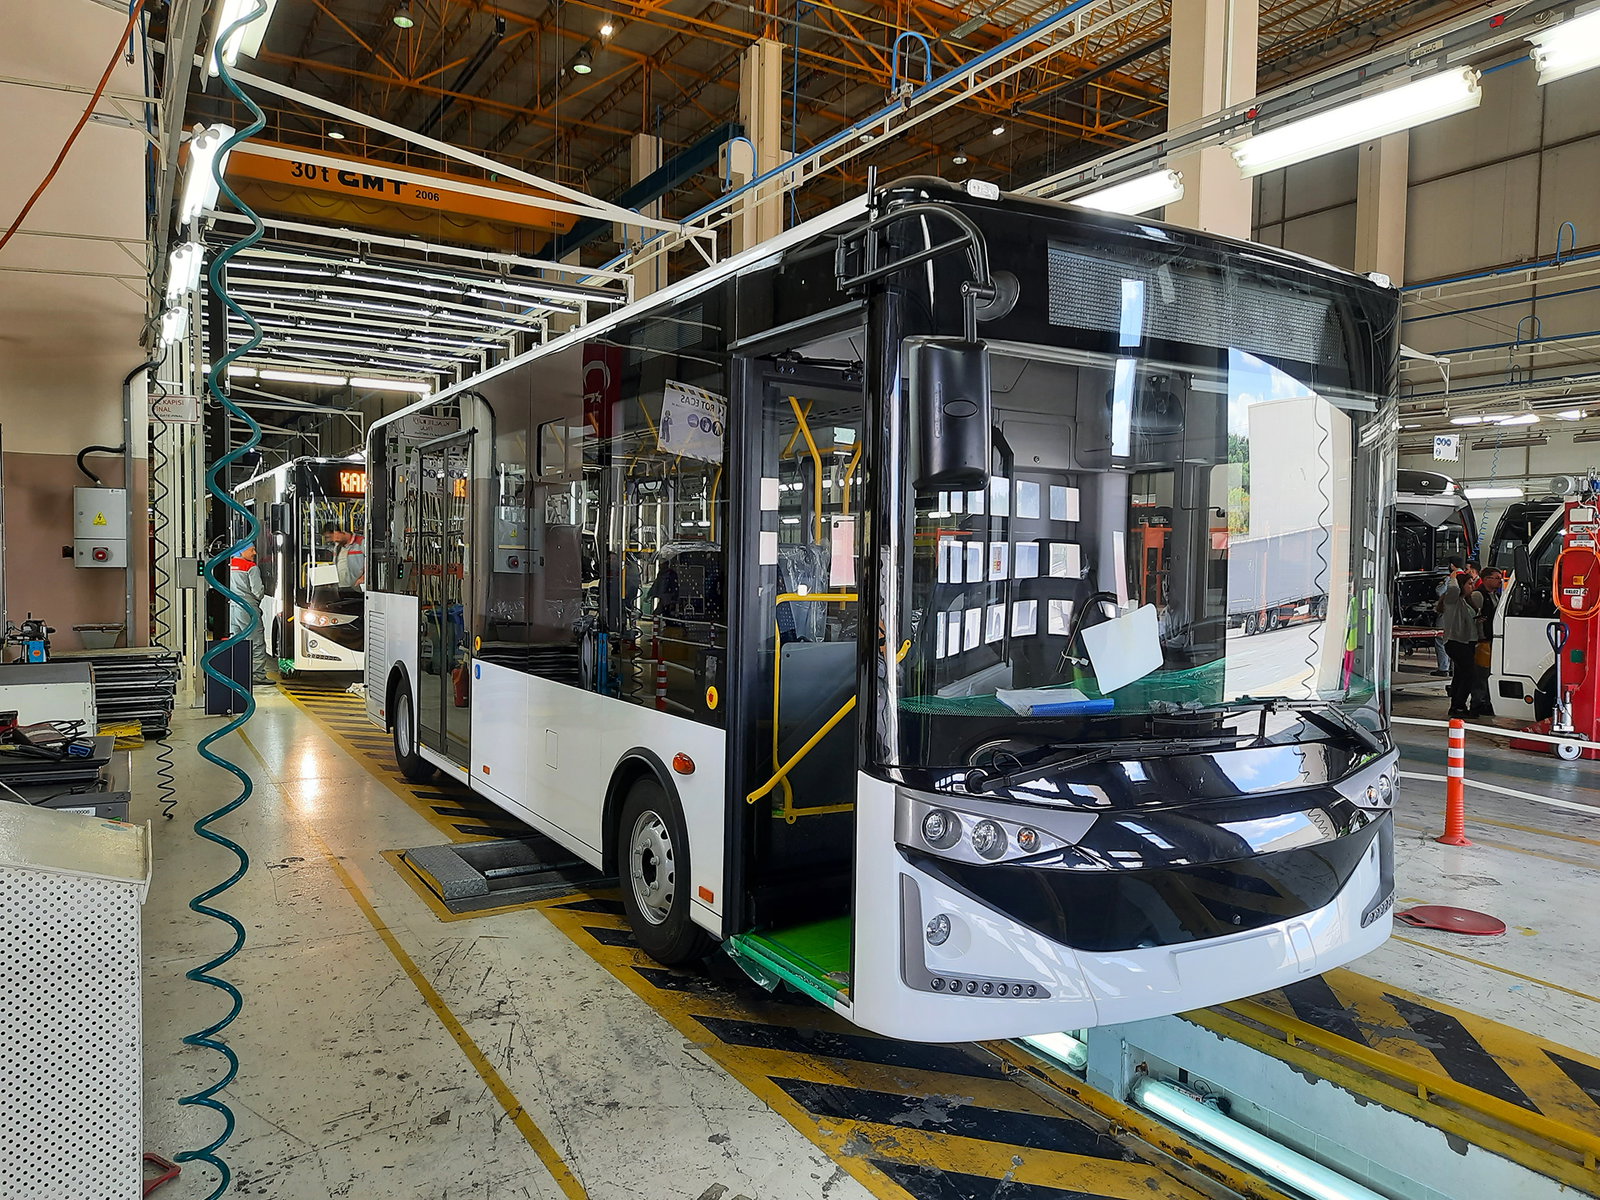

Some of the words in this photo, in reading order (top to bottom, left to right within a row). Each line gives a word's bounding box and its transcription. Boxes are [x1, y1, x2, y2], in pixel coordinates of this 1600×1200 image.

[291, 161, 317, 180] 30
[337, 170, 408, 195] GMT
[415, 190, 440, 202] 2006
